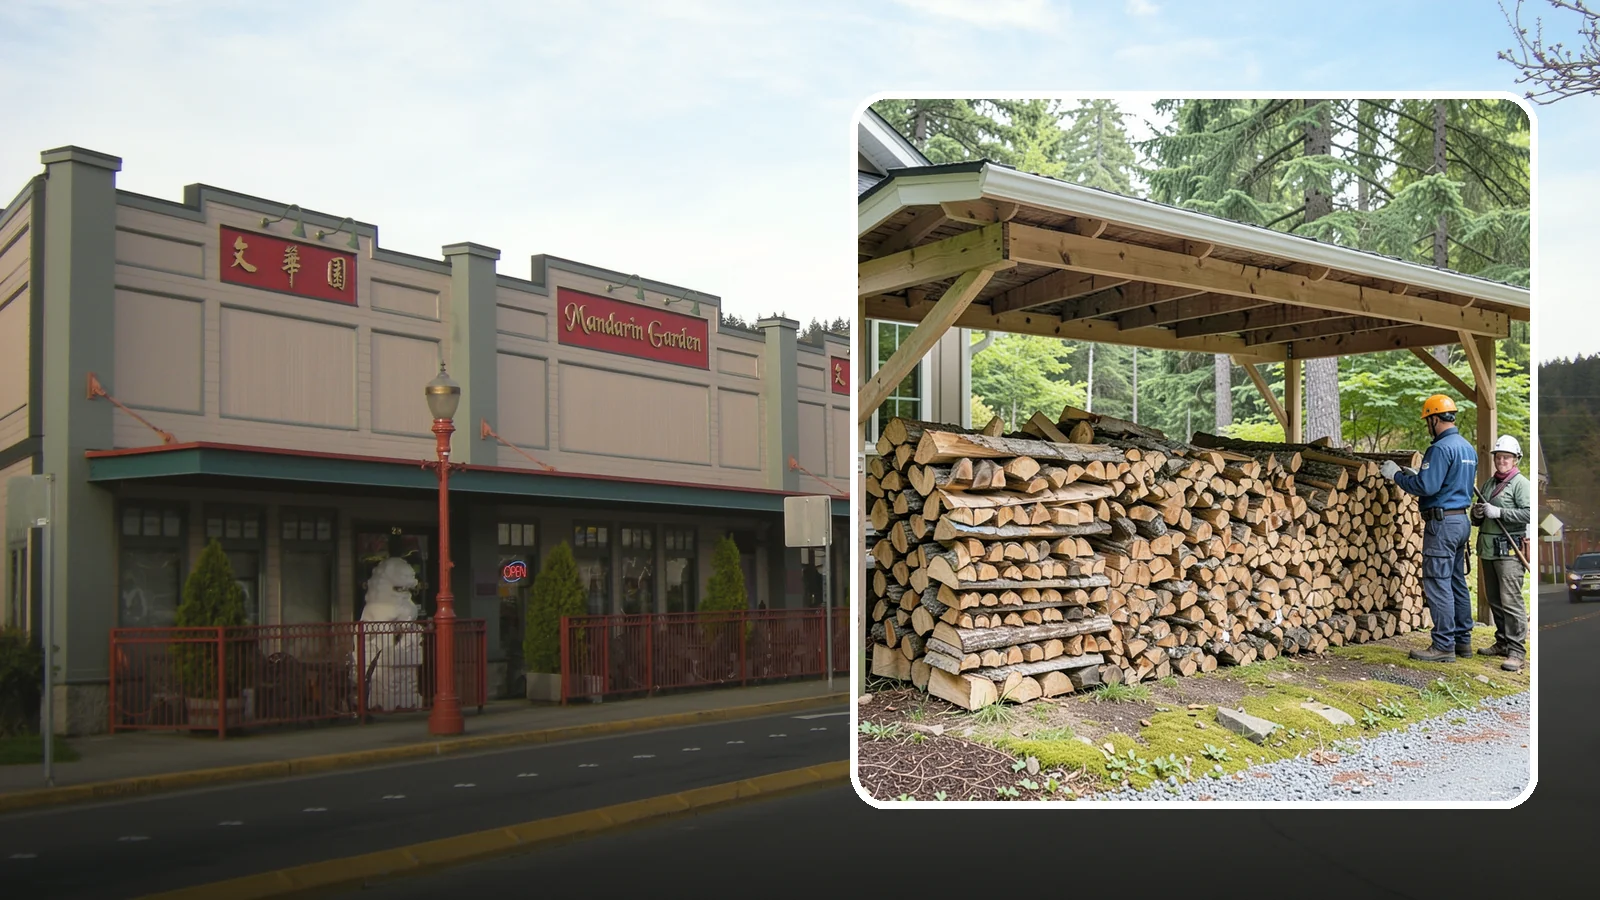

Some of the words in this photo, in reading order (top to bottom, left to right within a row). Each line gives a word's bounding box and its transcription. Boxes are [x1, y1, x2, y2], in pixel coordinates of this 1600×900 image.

[564, 302, 644, 341] Mandarin
[647, 320, 702, 352] Garden
[503, 565, 527, 578] OPEN
